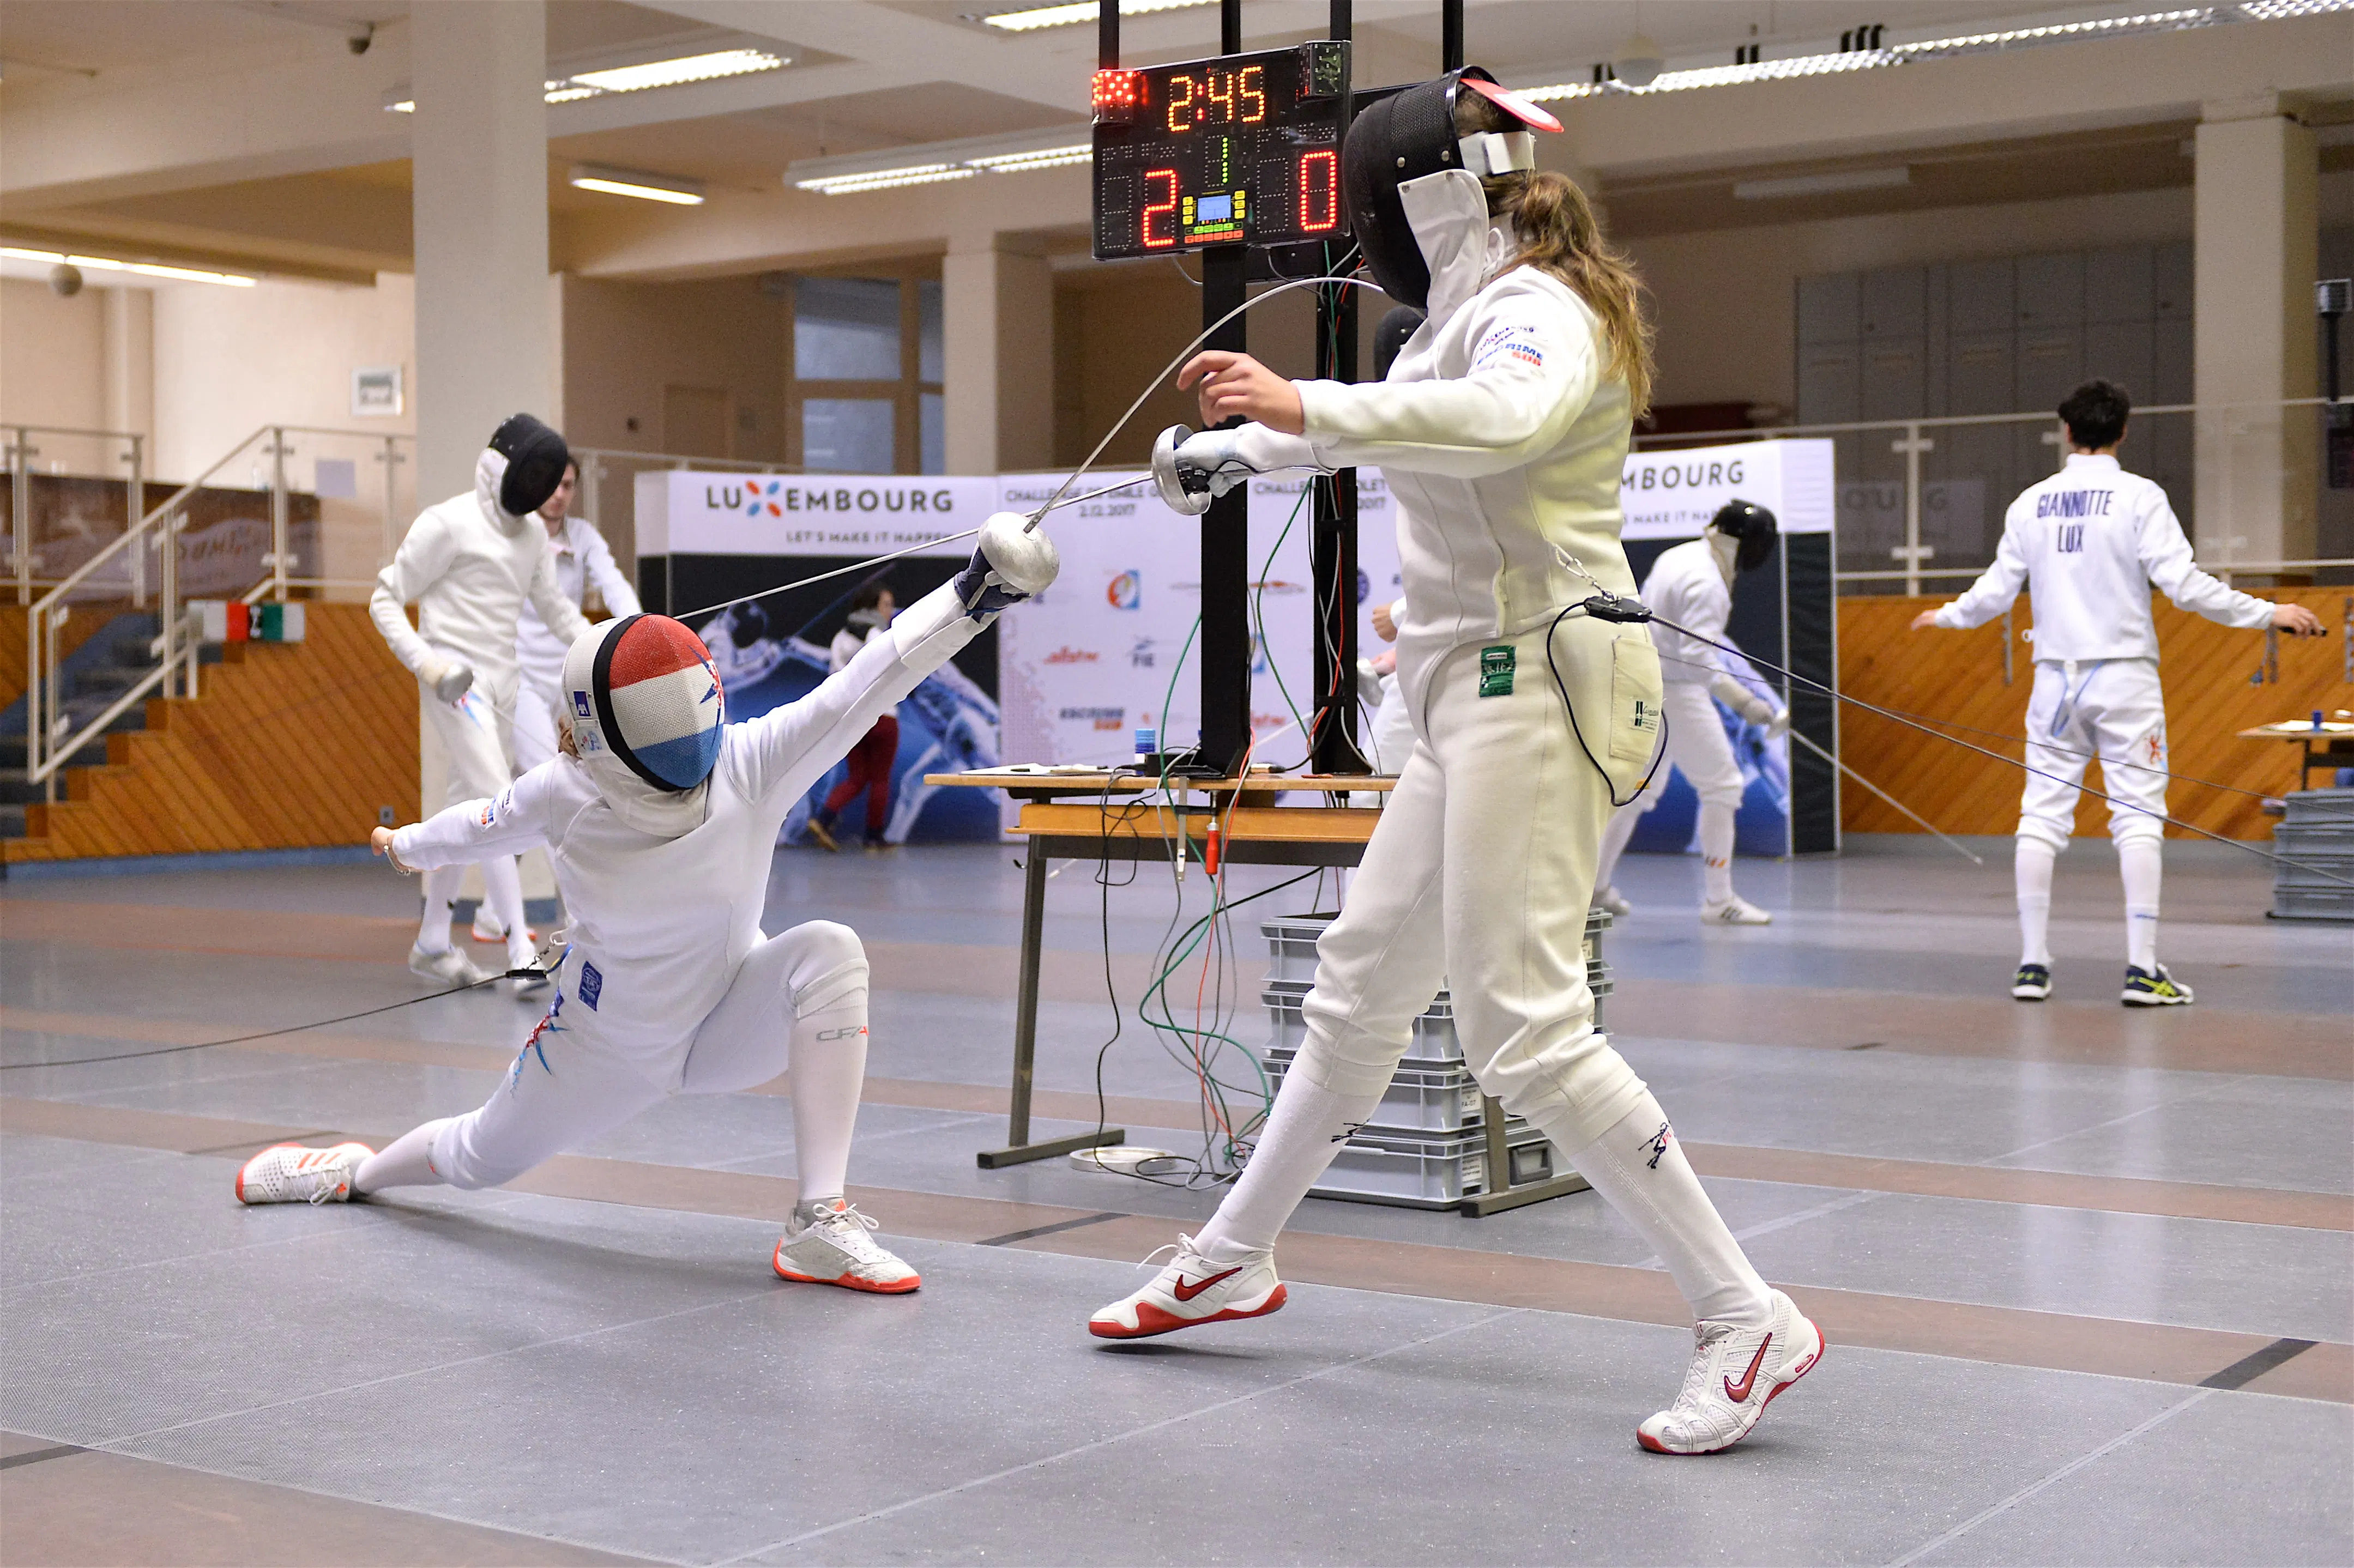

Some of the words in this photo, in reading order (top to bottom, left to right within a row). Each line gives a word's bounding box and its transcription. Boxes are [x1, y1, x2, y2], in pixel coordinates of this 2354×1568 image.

[1168, 65, 1265, 132] 2:45
[1143, 169, 1176, 247] 2
[1300, 150, 1337, 232] 0
[829, 531, 870, 543] MAKE
[2057, 523, 2085, 553] LUX
